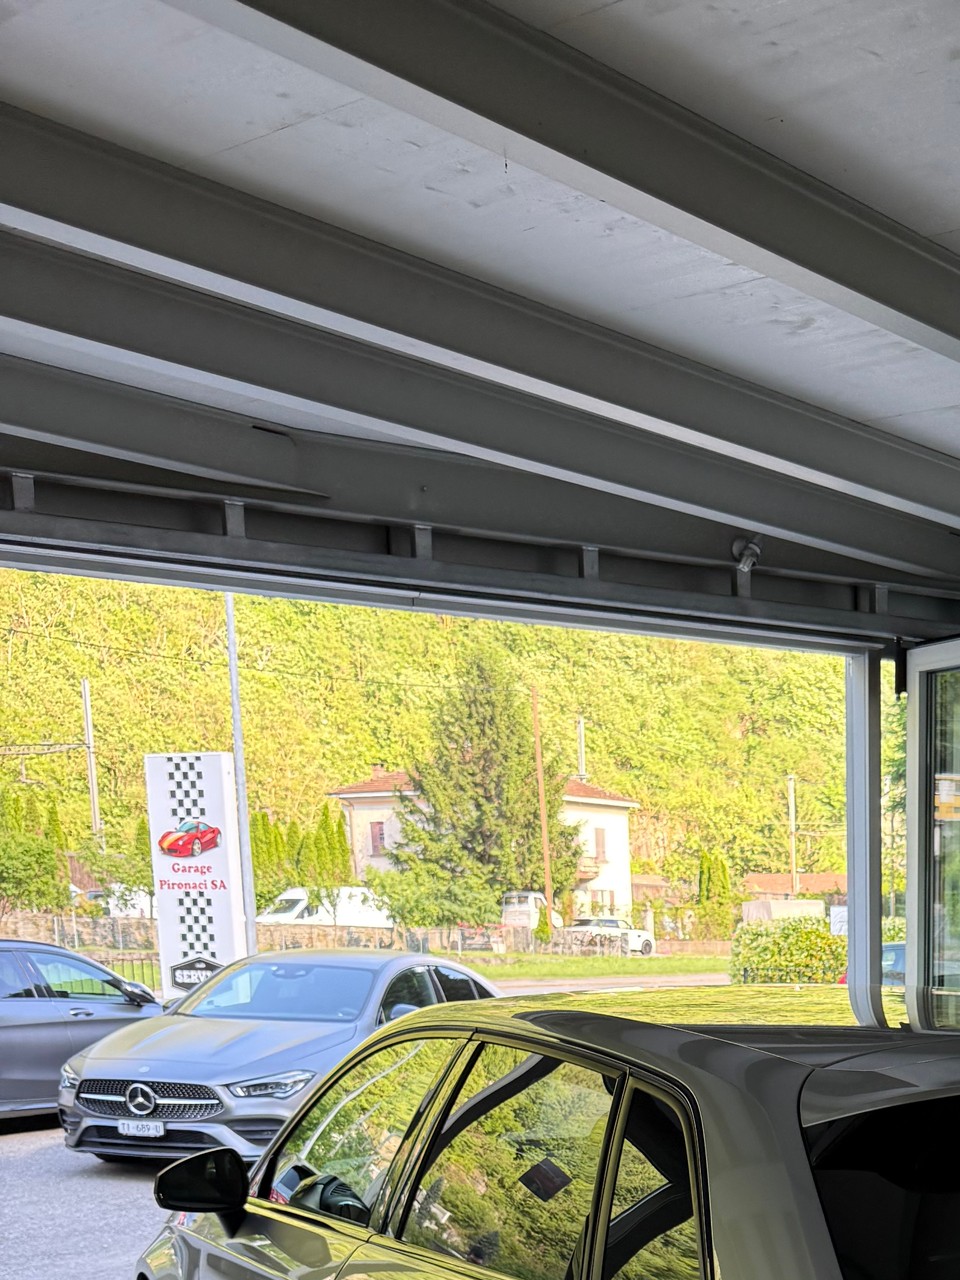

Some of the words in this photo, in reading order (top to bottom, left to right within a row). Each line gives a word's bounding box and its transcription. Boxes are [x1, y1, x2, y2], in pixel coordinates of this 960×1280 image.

[172, 863, 212, 875] Garage
[159, 879, 207, 890] Pironaci
[211, 880, 227, 890] SA
